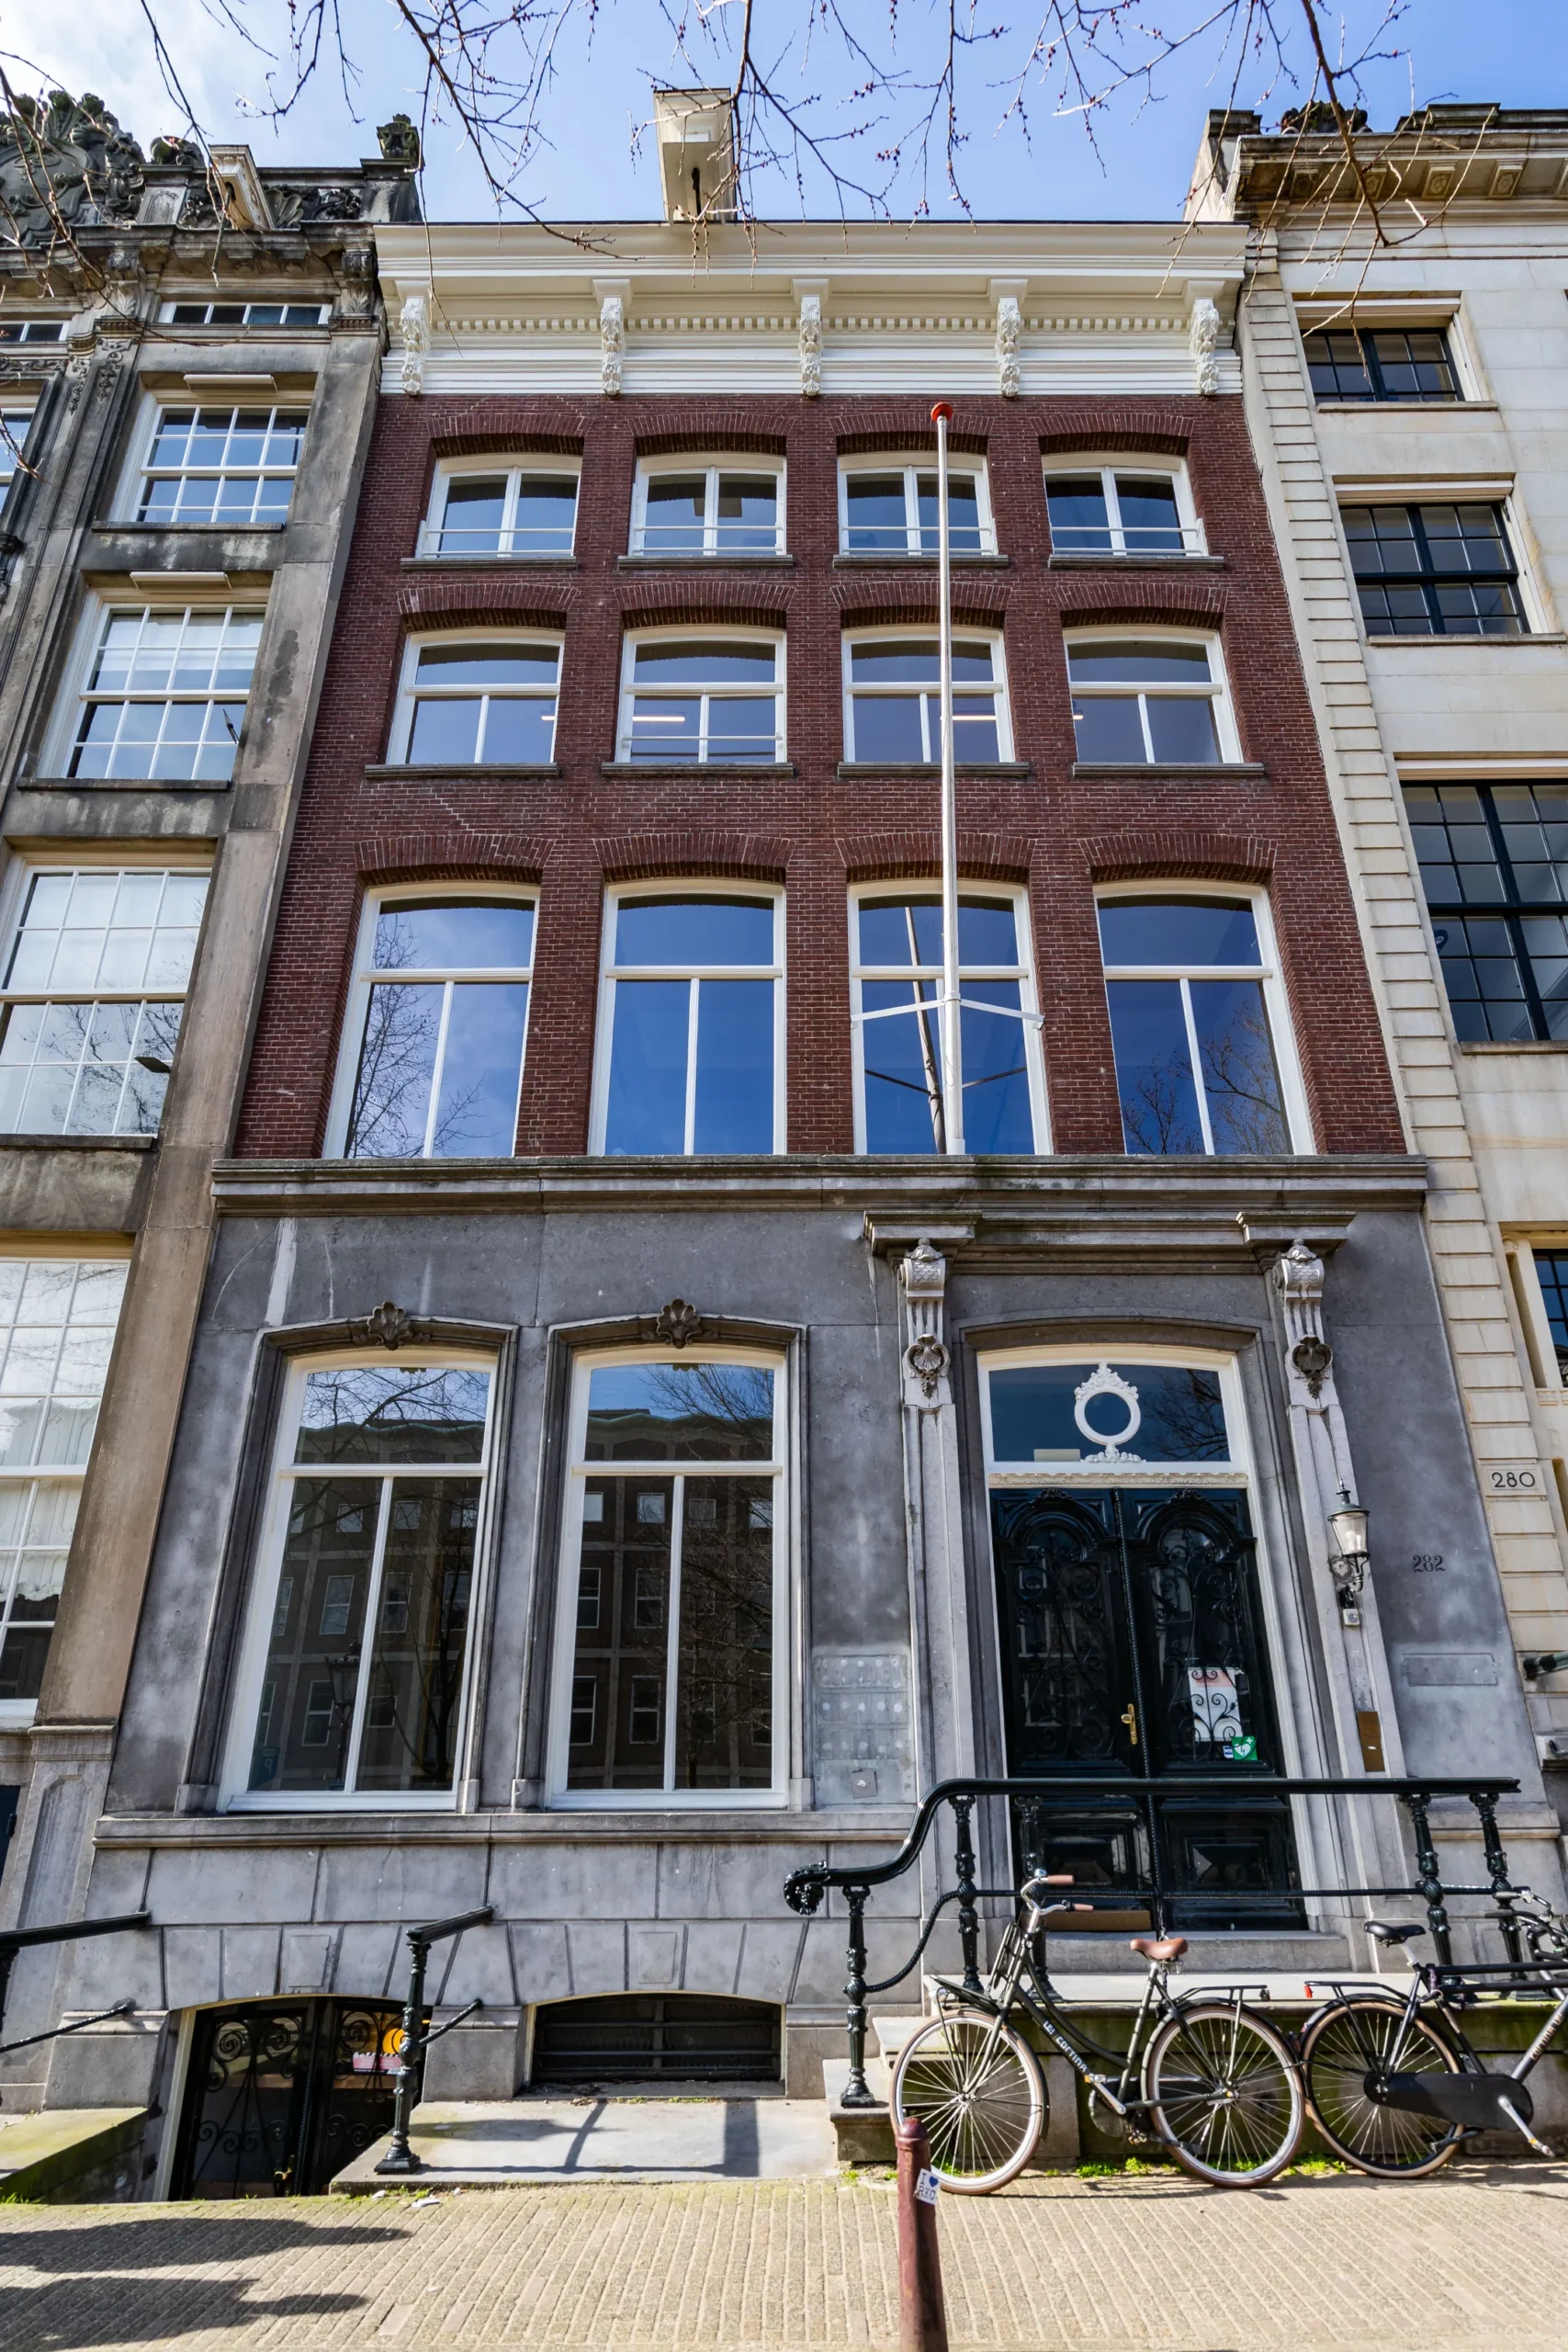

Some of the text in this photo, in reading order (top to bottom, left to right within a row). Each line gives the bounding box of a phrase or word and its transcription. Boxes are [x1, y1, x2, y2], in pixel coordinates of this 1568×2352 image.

[1491, 1471, 1536, 1487] 280
[1412, 1555, 1446, 1573] 282
[919, 2172, 927, 2185] I
